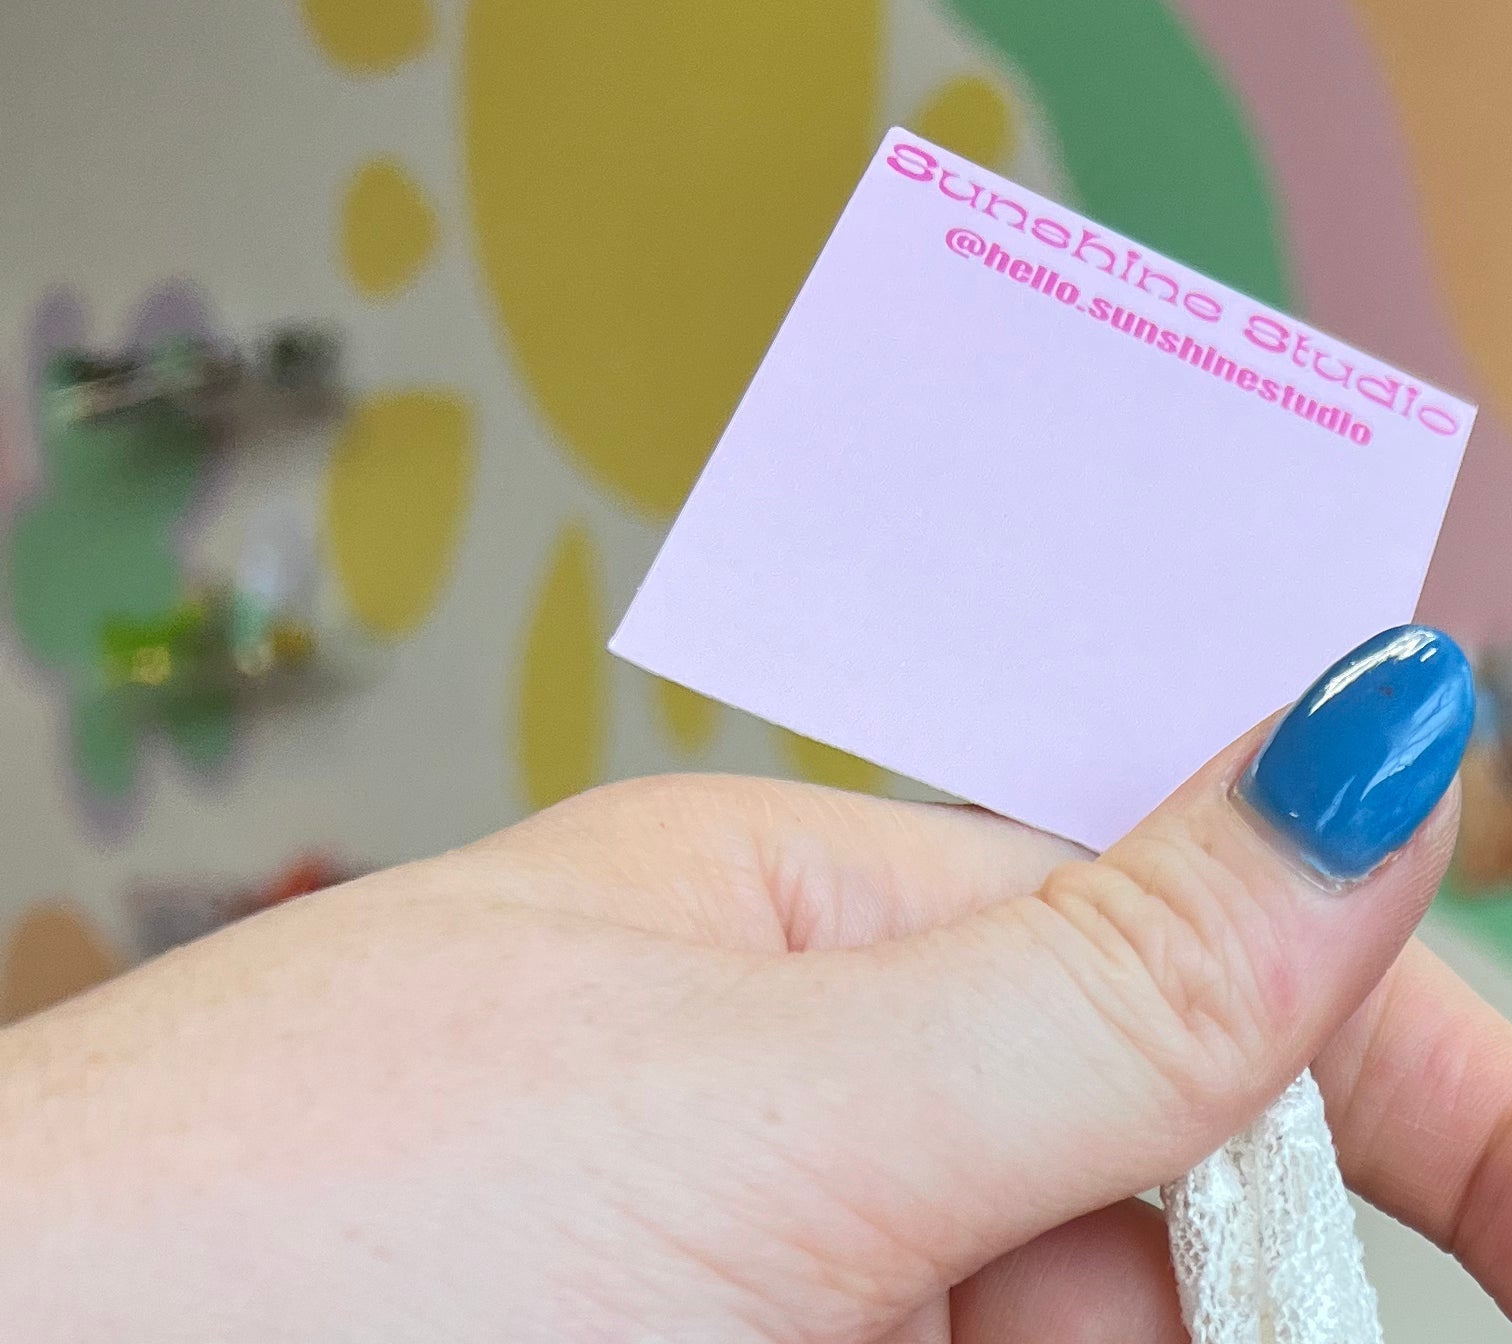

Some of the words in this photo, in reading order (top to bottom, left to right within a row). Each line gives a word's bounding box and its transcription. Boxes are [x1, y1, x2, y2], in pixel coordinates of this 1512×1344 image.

[886, 143, 1223, 323] Sunshine
[1243, 314, 1460, 437] Studio
[945, 226, 1372, 446] @hello.sunshinestudio
